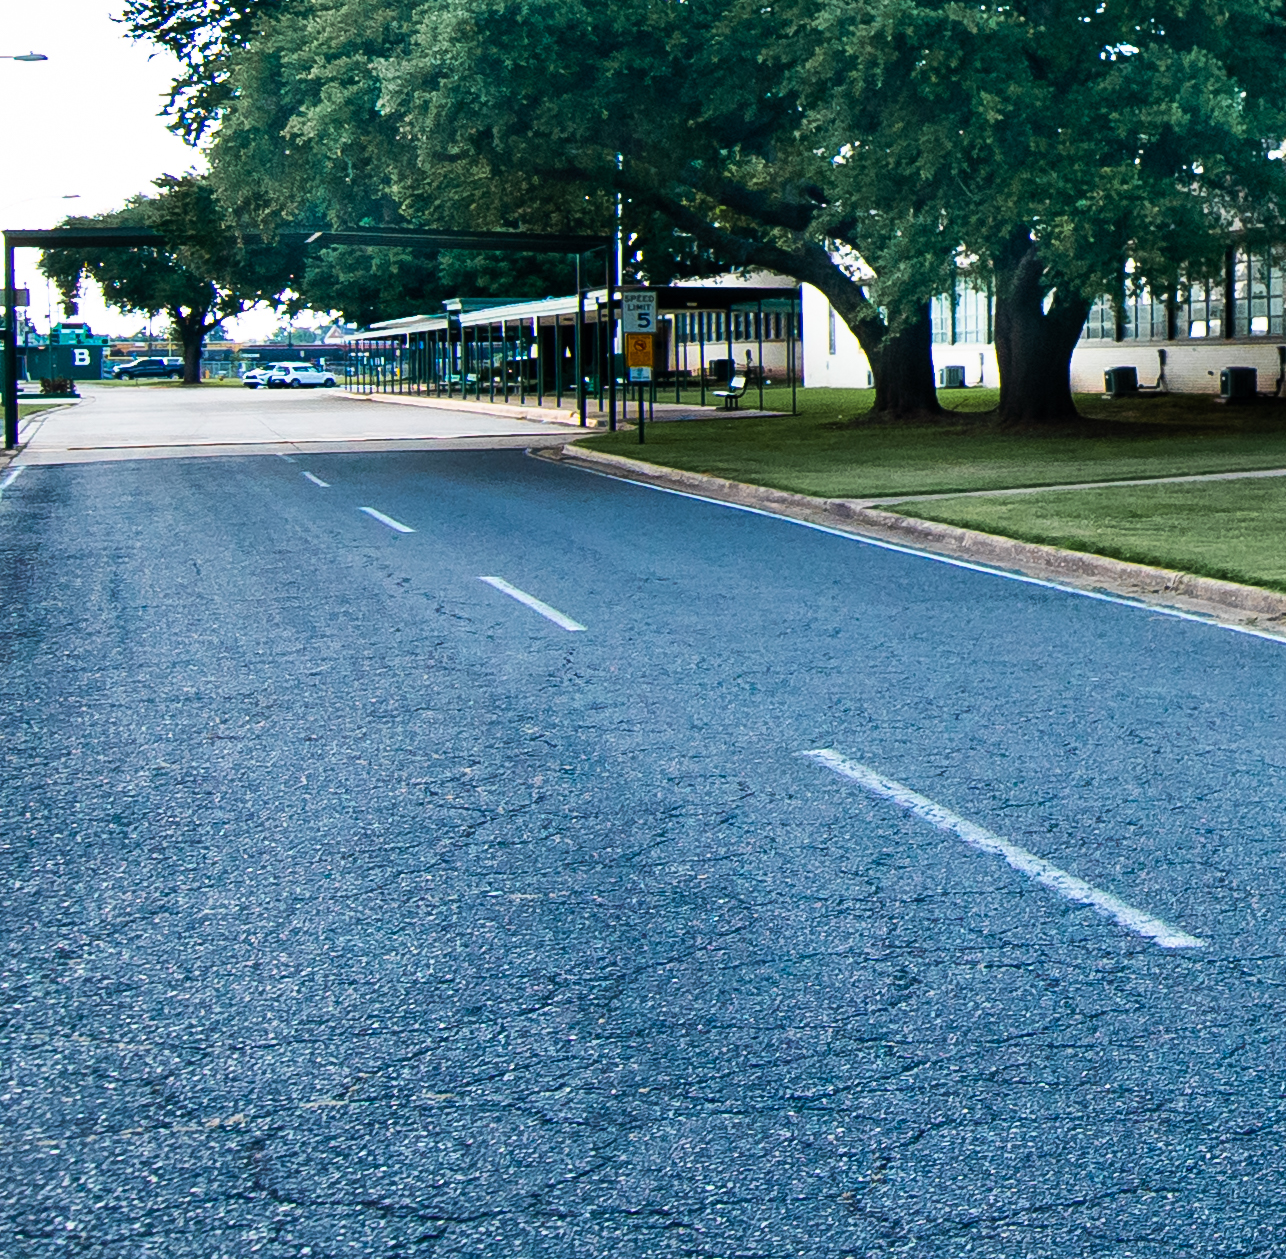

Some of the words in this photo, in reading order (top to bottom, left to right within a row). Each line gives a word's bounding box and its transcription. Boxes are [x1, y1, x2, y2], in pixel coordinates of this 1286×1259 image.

[624, 295, 655, 303] SPEED
[637, 312, 652, 328] 5
[73, 348, 91, 366] B
